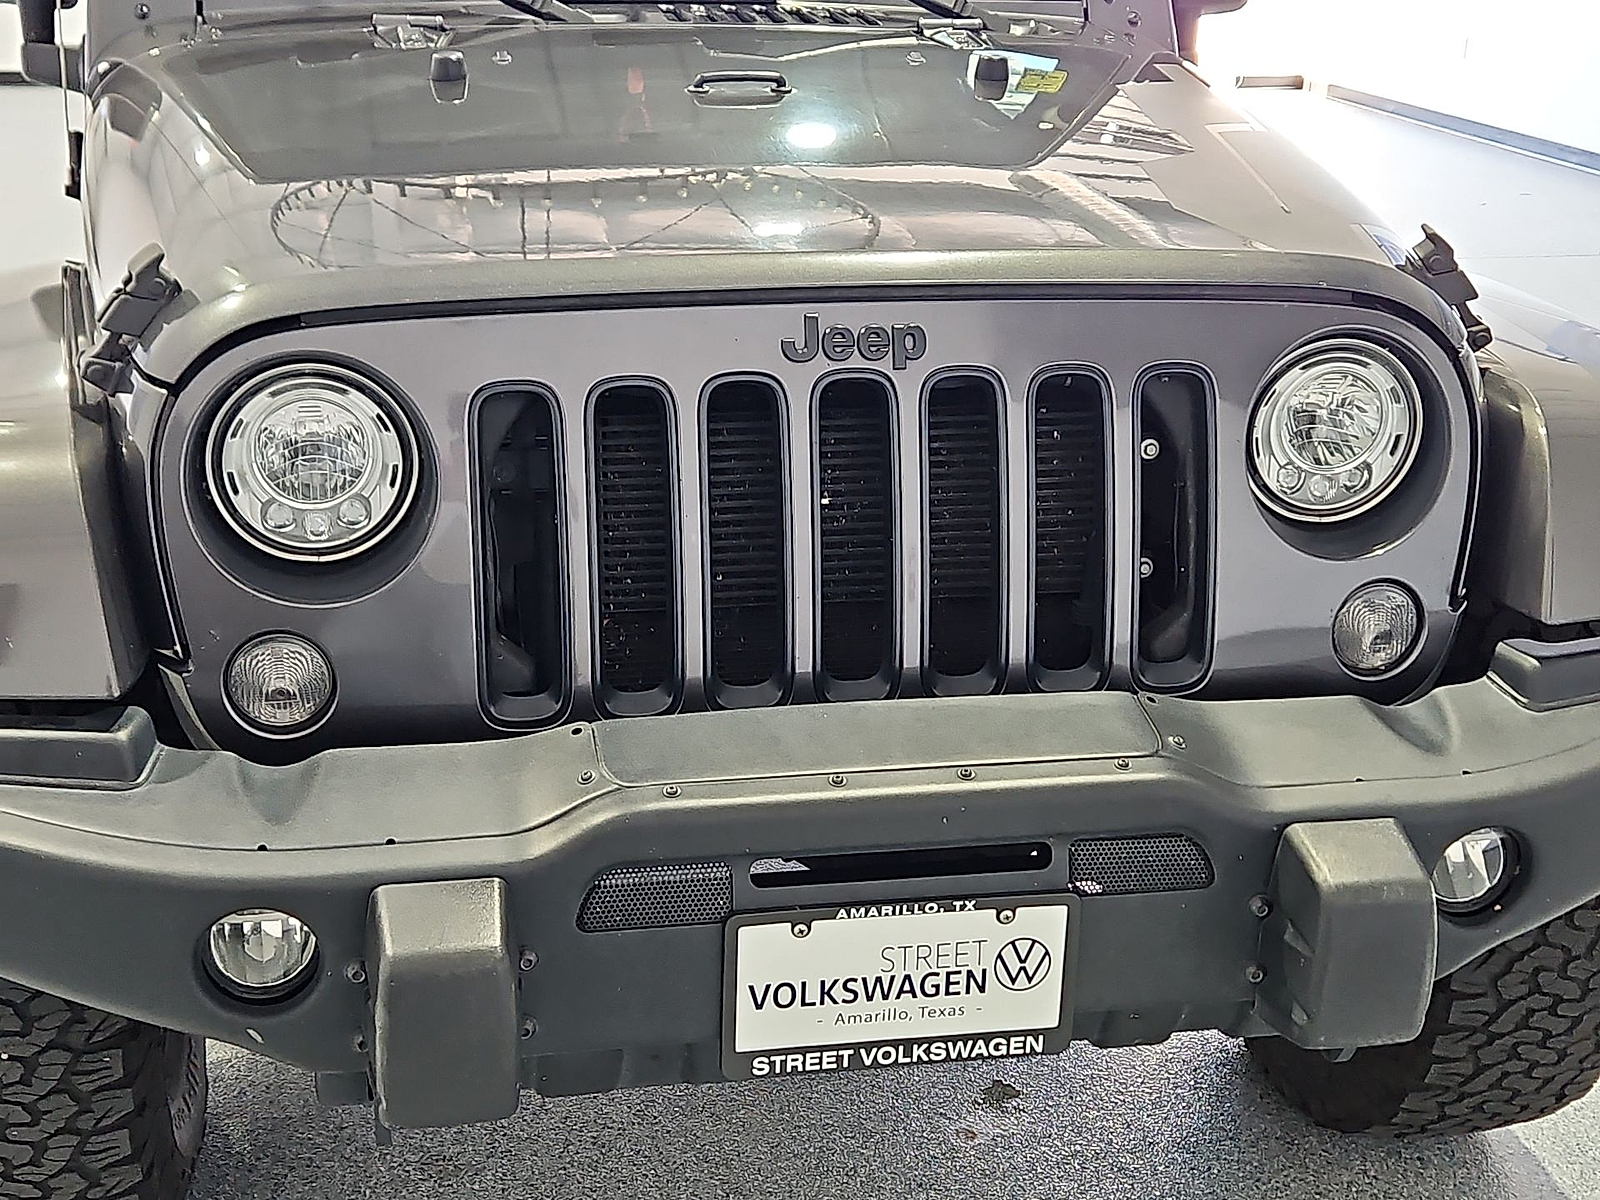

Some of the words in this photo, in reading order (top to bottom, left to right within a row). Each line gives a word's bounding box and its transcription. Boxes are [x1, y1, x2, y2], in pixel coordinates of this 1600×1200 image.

[781, 312, 927, 370] Jeep
[835, 902, 945, 920] AMARILLO,
[952, 899, 977, 913] TX
[880, 939, 988, 973] STREET
[748, 967, 988, 1011] VOLKSWAGEN
[834, 1007, 914, 1026] Amarillo,
[918, 1004, 966, 1020] Texas
[751, 1048, 853, 1077] STREET
[859, 1034, 1045, 1069] VOLKSWAGEN
